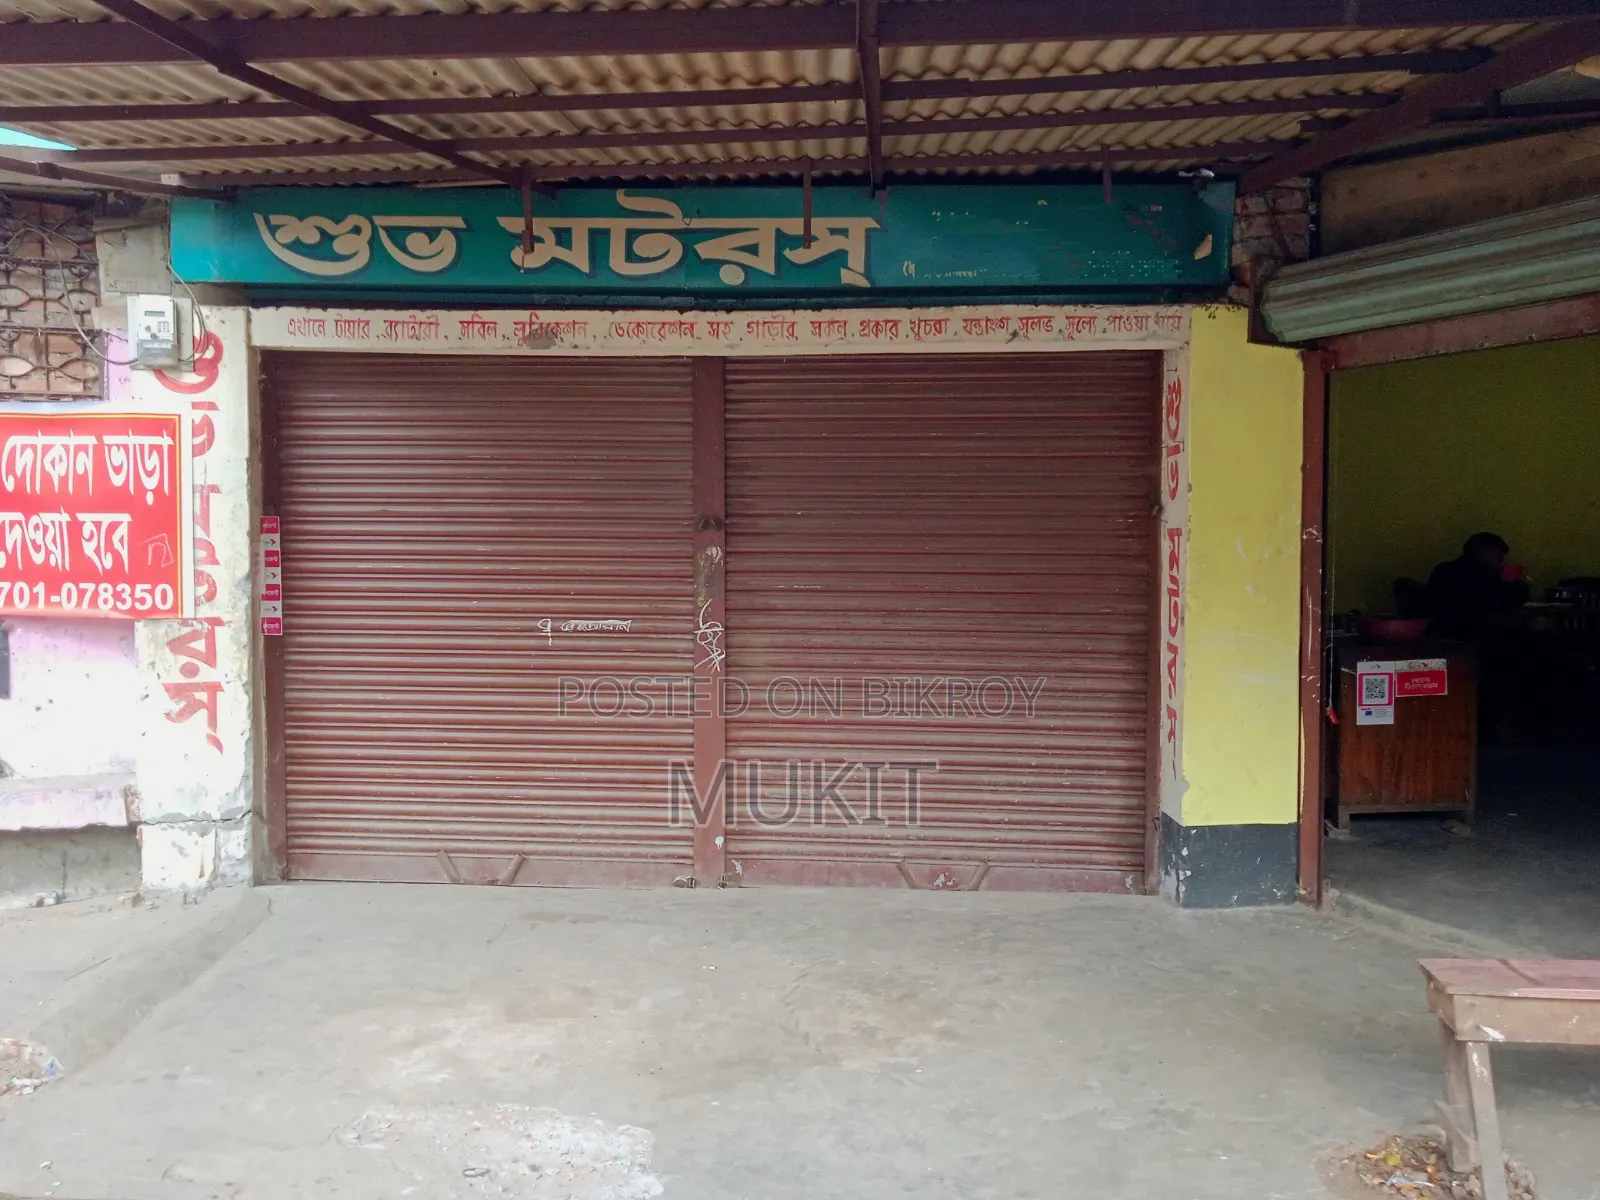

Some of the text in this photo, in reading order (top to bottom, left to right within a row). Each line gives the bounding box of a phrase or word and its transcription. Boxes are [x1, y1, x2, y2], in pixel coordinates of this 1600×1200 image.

[252, 211, 467, 276] শুভ
[288, 316, 328, 337] এখানে
[706, 319, 733, 340] সহ
[809, 318, 848, 340] সকল
[859, 317, 902, 341] প্রকার
[909, 316, 951, 342] খুচরা
[1, 429, 175, 506] দোকান ভাড়া
[75, 512, 133, 576] হবে
[0, 581, 174, 612] 701-078350
